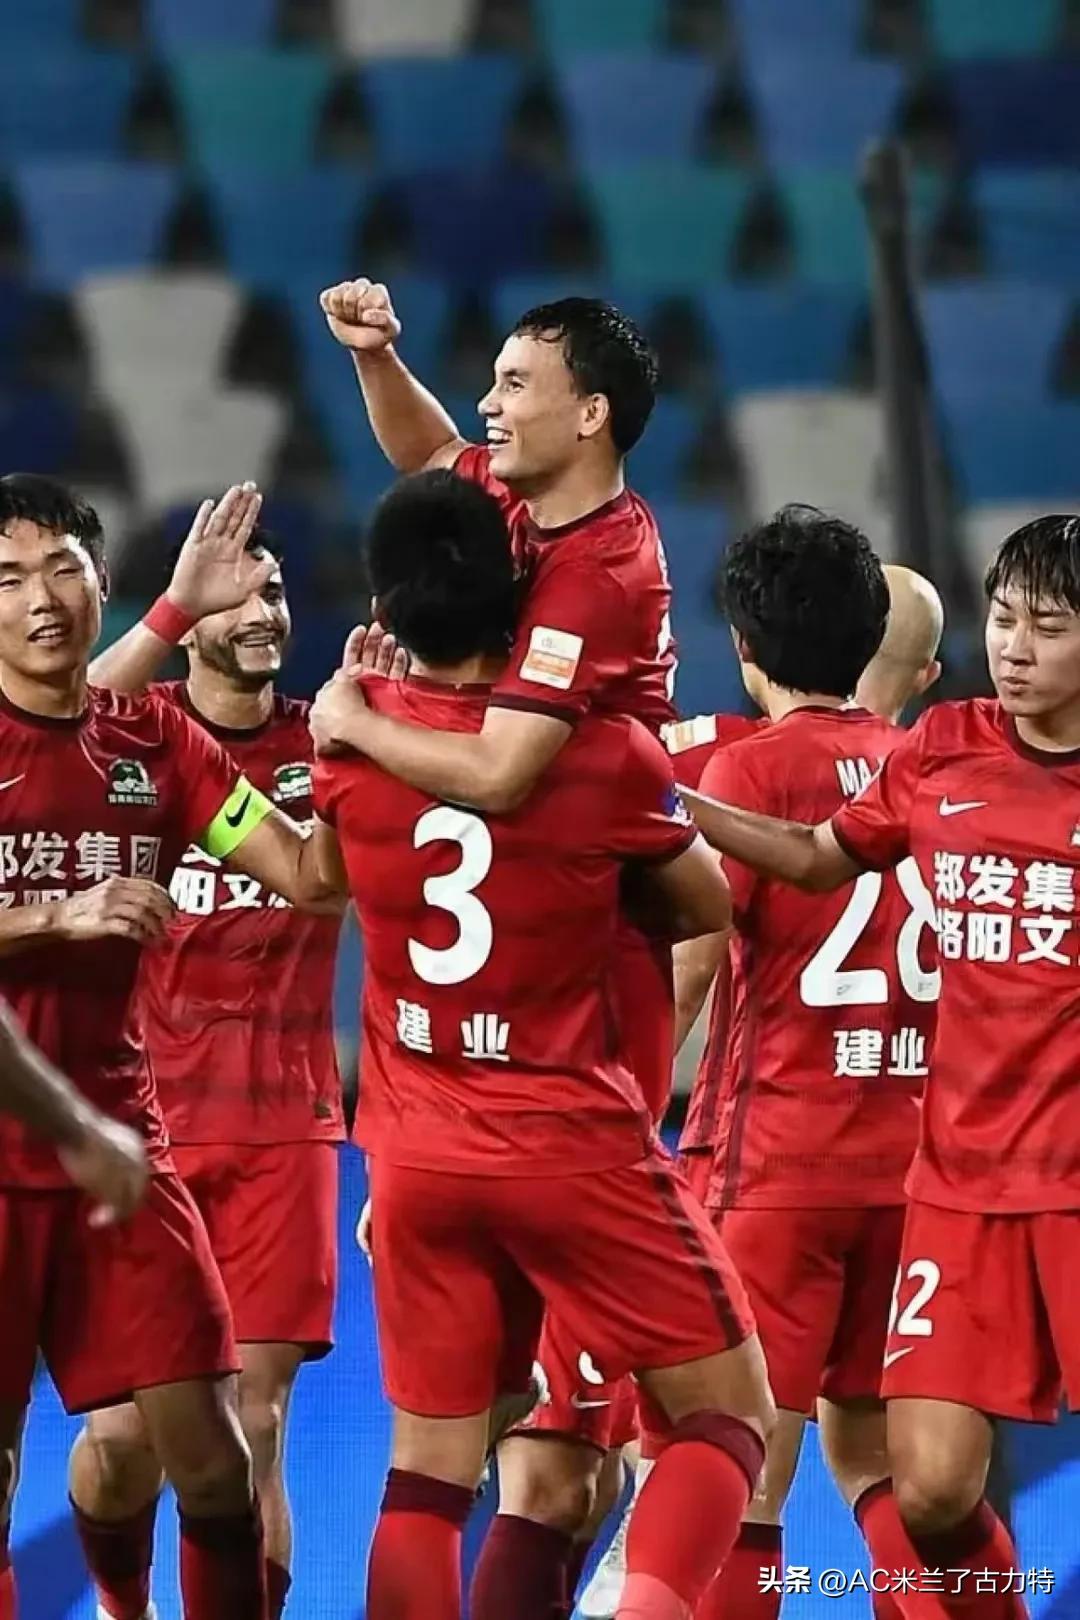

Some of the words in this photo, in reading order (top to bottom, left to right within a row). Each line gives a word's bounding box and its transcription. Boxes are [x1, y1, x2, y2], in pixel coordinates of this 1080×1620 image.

[836, 757, 883, 799] MA
[408, 806, 493, 985] 3
[396, 998, 511, 1062] 建业
[833, 1027, 929, 1078] 建业
[888, 1258, 941, 1336] 2
